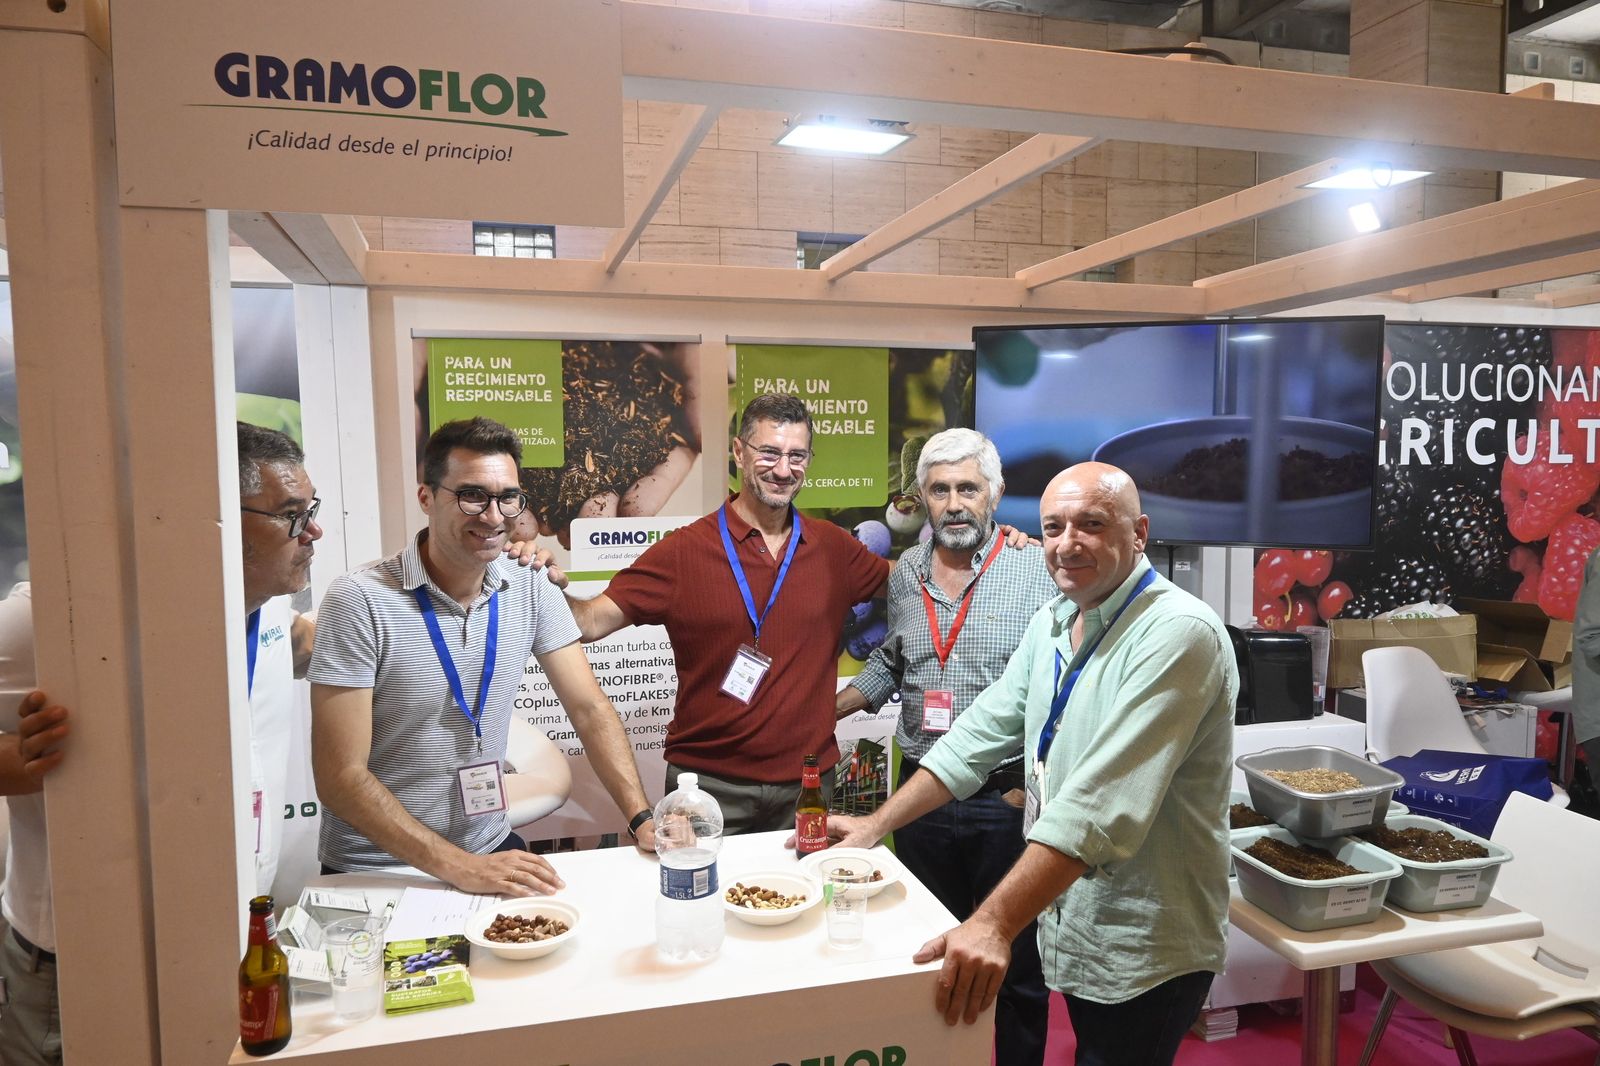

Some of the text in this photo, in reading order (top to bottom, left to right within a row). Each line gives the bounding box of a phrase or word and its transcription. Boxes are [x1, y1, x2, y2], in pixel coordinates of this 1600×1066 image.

[214, 52, 548, 119] GRAMOFLOR
[247, 130, 514, 165] ¡Calidad desde el principio!
[445, 356, 511, 369] PARA UN
[445, 373, 546, 386] CRECIMIENTO
[754, 378, 830, 393] PARA UN
[446, 389, 552, 402] RESPONSABLE
[802, 400, 868, 414] MIENTO
[532, 428, 543, 436] DE
[815, 478, 847, 488] CERCA
[850, 478, 861, 487] DE
[863, 478, 873, 487] TI!
[627, 640, 656, 651] turba
[615, 656, 674, 669] alternativa
[513, 696, 671, 721] COplus y de Km
[527, 713, 561, 726] prima
